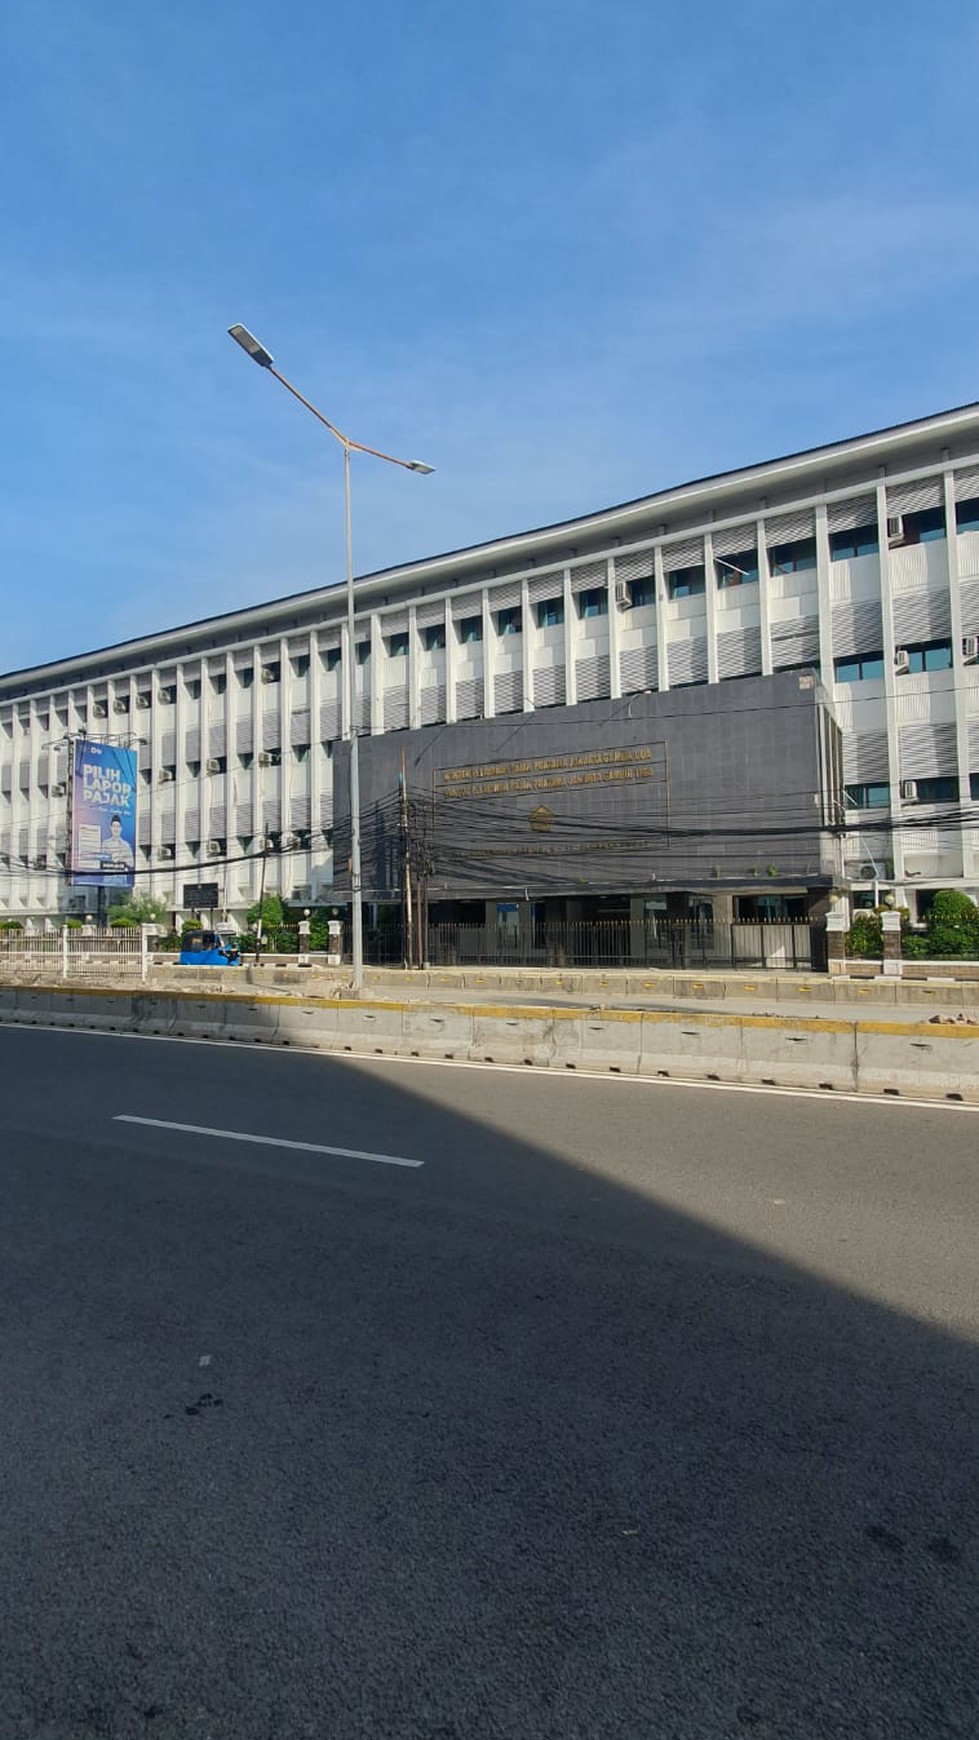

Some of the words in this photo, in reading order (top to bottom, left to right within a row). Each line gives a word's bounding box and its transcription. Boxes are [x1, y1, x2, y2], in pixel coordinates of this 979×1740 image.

[83, 763, 120, 781] PILIH
[83, 777, 132, 799] LAPOR
[83, 789, 129, 808] PAJAK
